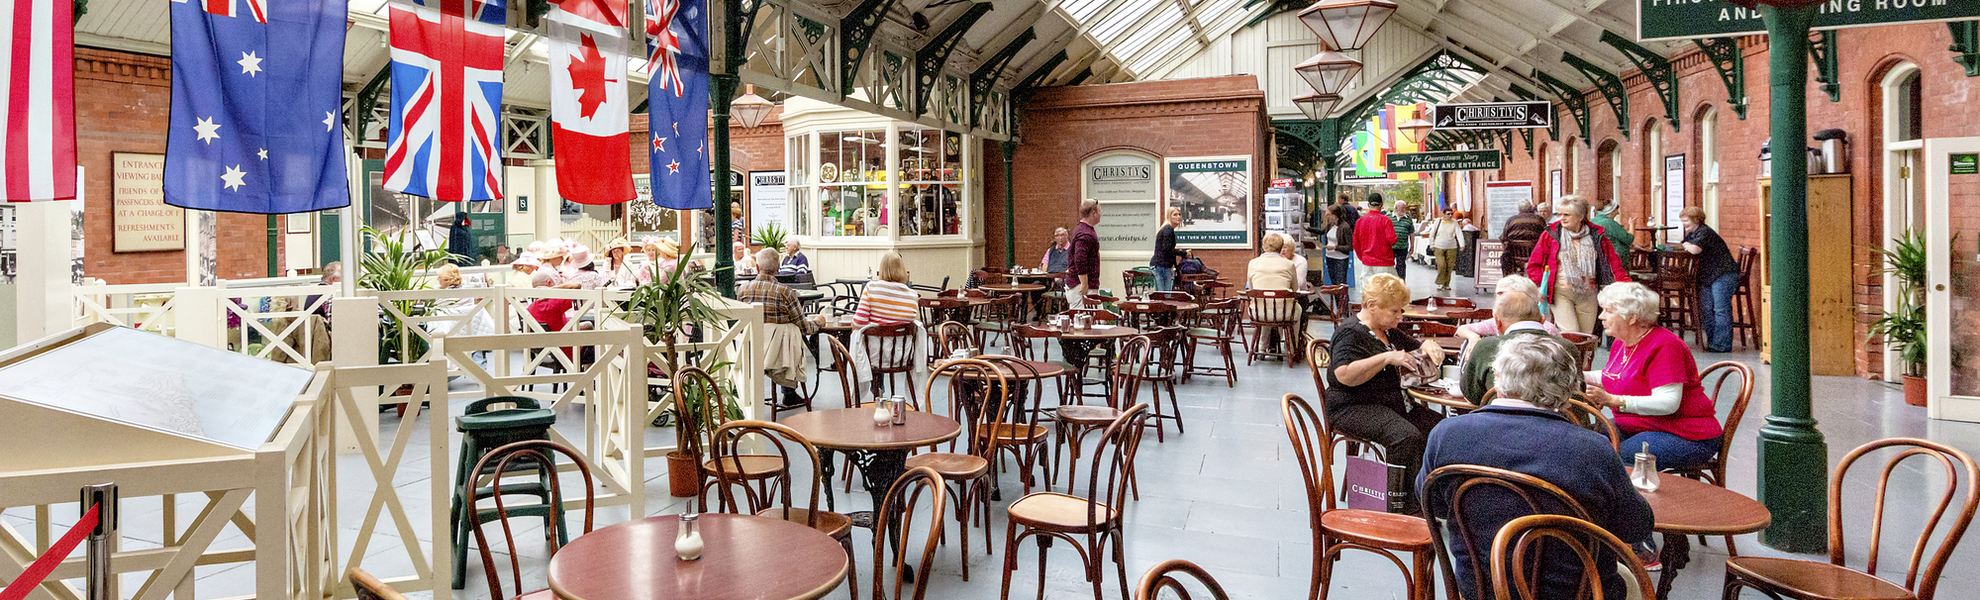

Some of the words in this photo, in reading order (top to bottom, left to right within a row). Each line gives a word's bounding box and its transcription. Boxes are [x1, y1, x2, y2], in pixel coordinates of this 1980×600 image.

[1457, 106, 1525, 121] CHRISTYS
[1423, 154, 1461, 164] Queenstown
[1463, 153, 1480, 161] Story
[1458, 161, 1497, 169] ENTRANCE
[1094, 166, 1149, 180] CHRISTYS
[1352, 485, 1385, 500] CHRISTYS
